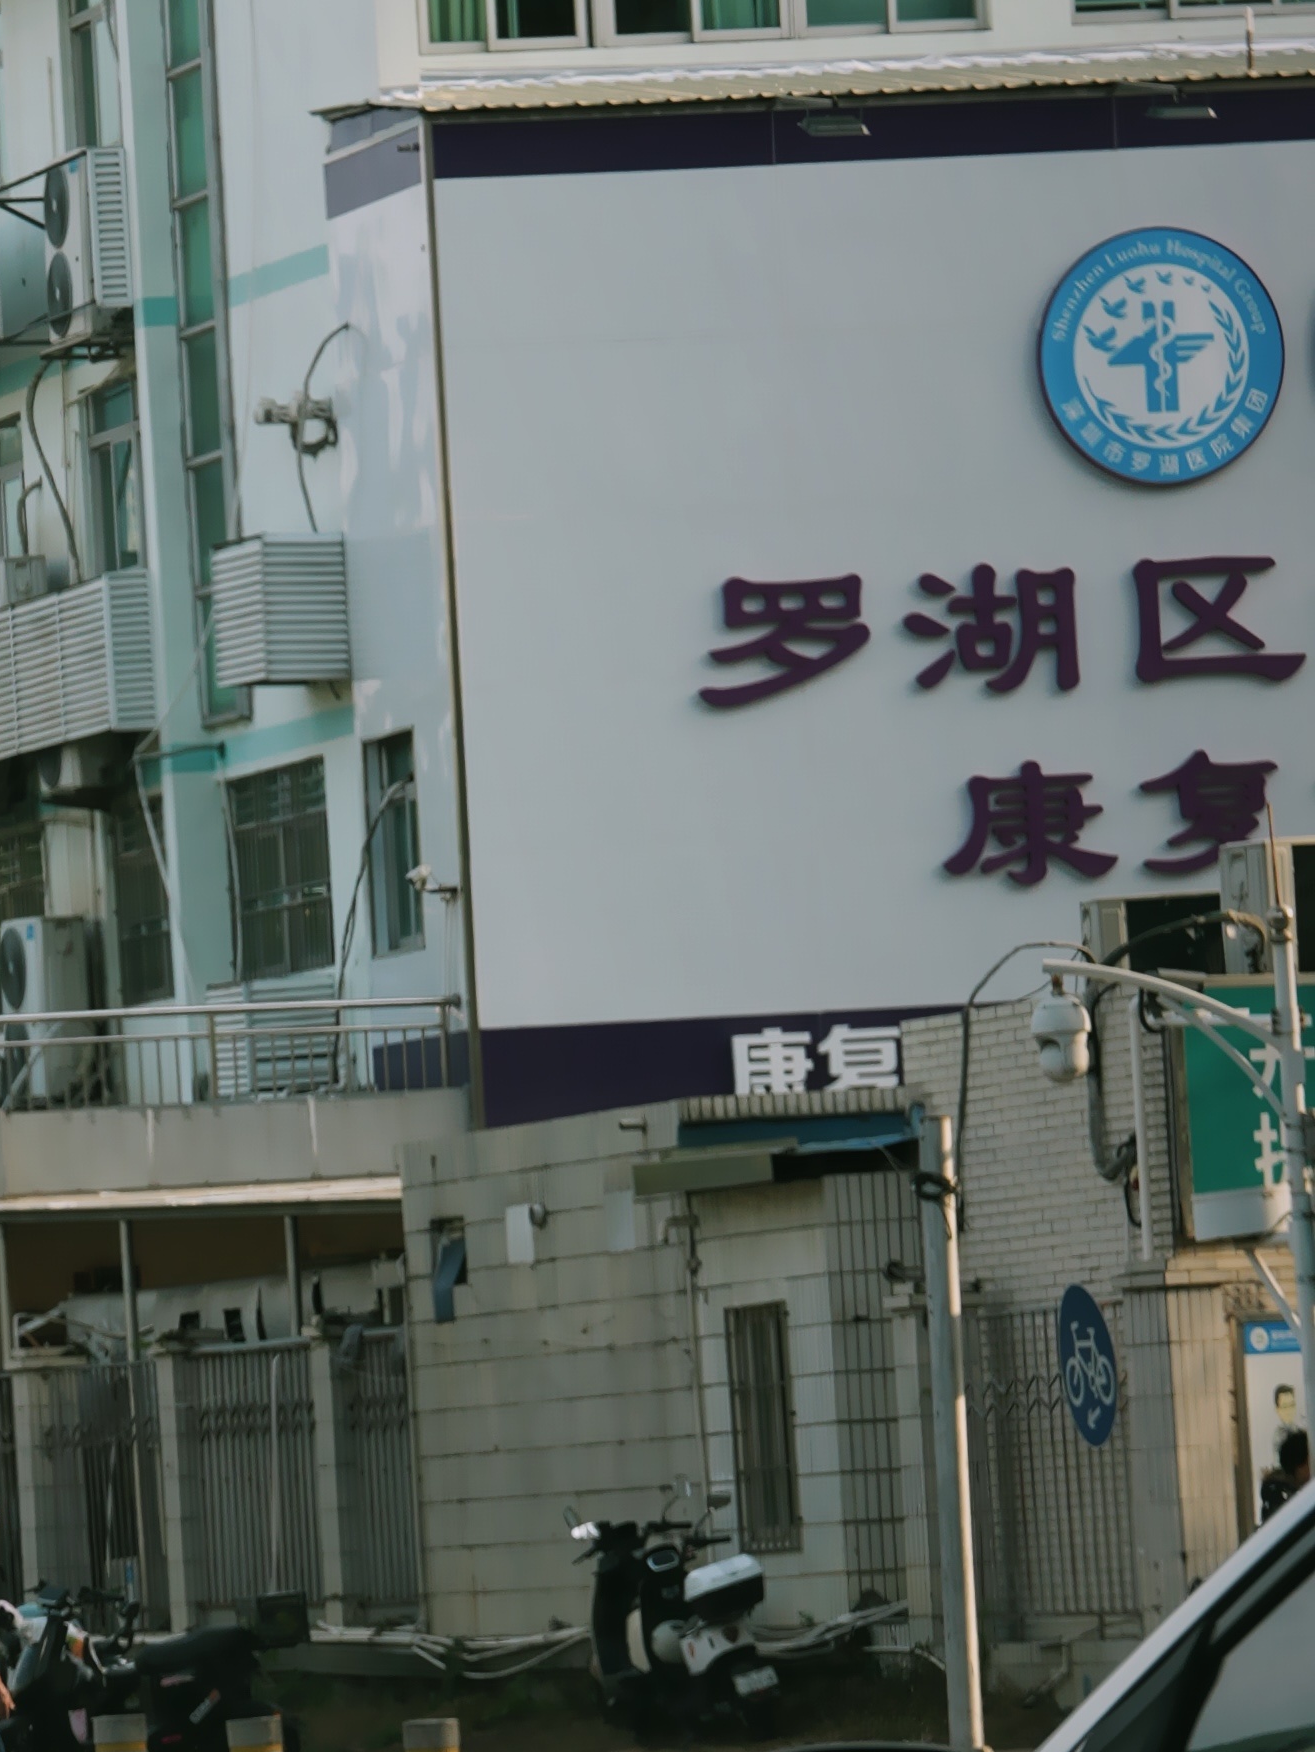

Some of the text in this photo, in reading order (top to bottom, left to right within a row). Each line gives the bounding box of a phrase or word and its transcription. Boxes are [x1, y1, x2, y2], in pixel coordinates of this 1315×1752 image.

[1234, 279, 1266, 335] Group
[697, 554, 1307, 708] 罗湖区
[942, 749, 1279, 887] 康复
[731, 1023, 901, 1096] 康复
